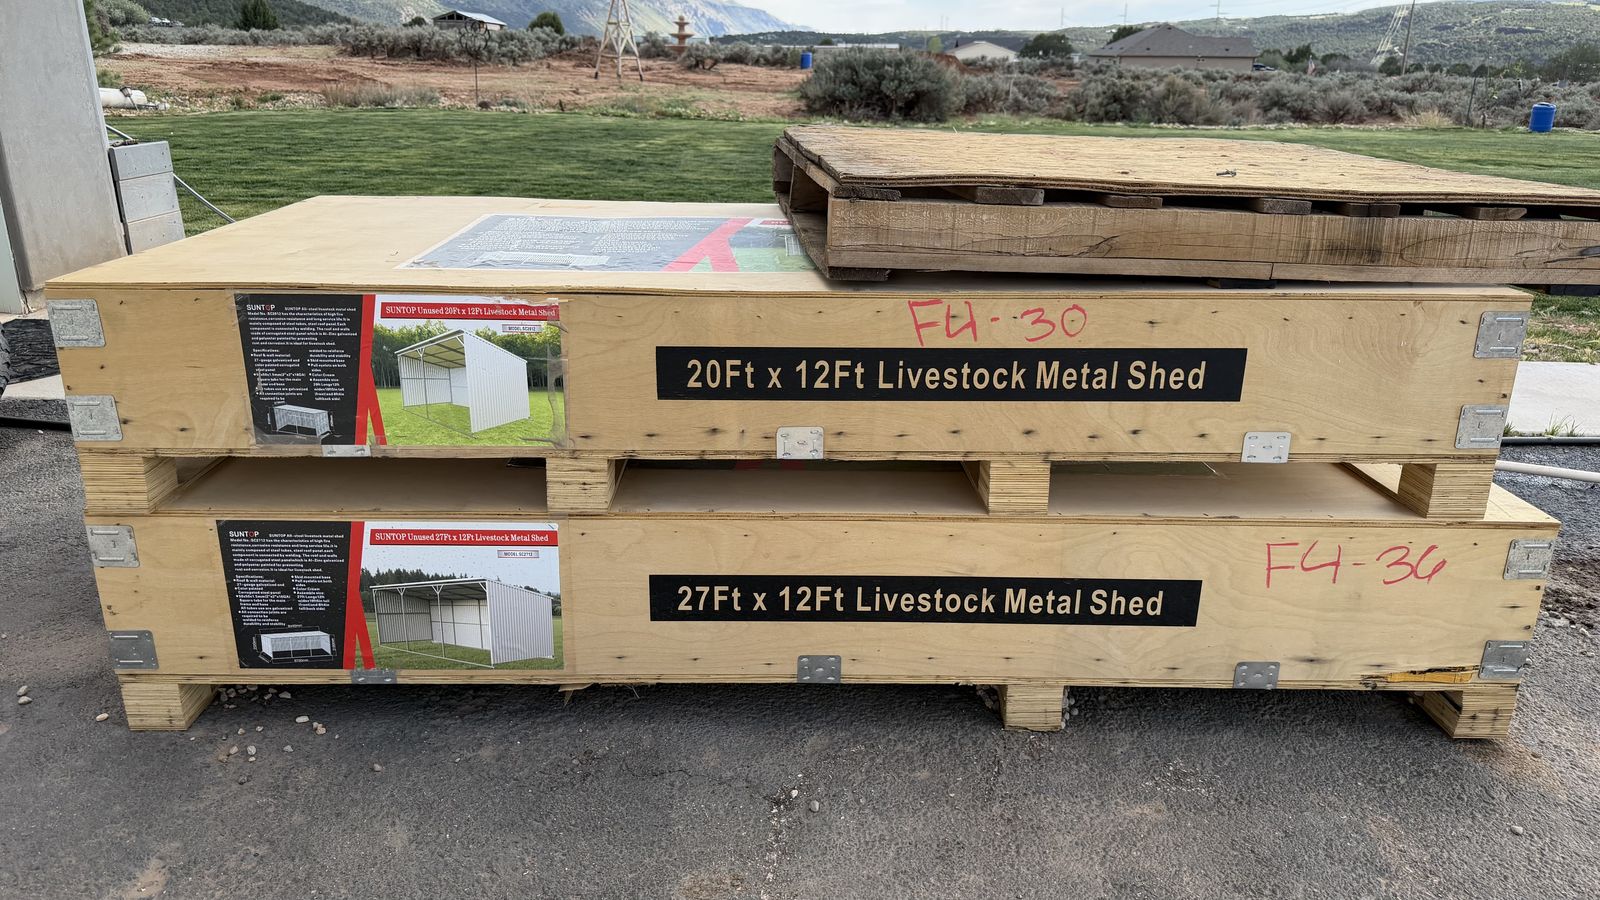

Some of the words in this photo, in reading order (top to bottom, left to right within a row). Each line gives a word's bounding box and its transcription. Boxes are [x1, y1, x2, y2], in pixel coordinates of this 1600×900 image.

[386, 306, 417, 314] SUNTOP
[418, 306, 445, 315] Unused
[445, 306, 461, 315] 20Ft
[467, 307, 483, 315] 12Ft
[484, 307, 517, 316] Livestock
[518, 308, 537, 316] Metal
[538, 308, 556, 316] Shed
[687, 358, 754, 389] 20Ft
[767, 366, 782, 389] x
[796, 358, 864, 389] 12Ft
[878, 360, 1027, 390] Livestock
[1035, 361, 1118, 390] Metal
[1127, 360, 1207, 390] Shed
[229, 530, 259, 538] SUNTOP
[375, 533, 407, 541] SUNTOP
[408, 533, 435, 541] Unused
[436, 533, 452, 541] 27Ft
[459, 534, 475, 542] 12Ft
[475, 534, 510, 543] Livestock
[511, 534, 530, 543] Metal
[531, 534, 549, 543] Shed
[677, 585, 742, 611] 27Ft
[753, 592, 768, 611] x
[779, 585, 845, 612] 12Ft
[856, 586, 996, 613] Livestock
[1004, 588, 1082, 614] Metal
[1089, 589, 1163, 616] Shed
